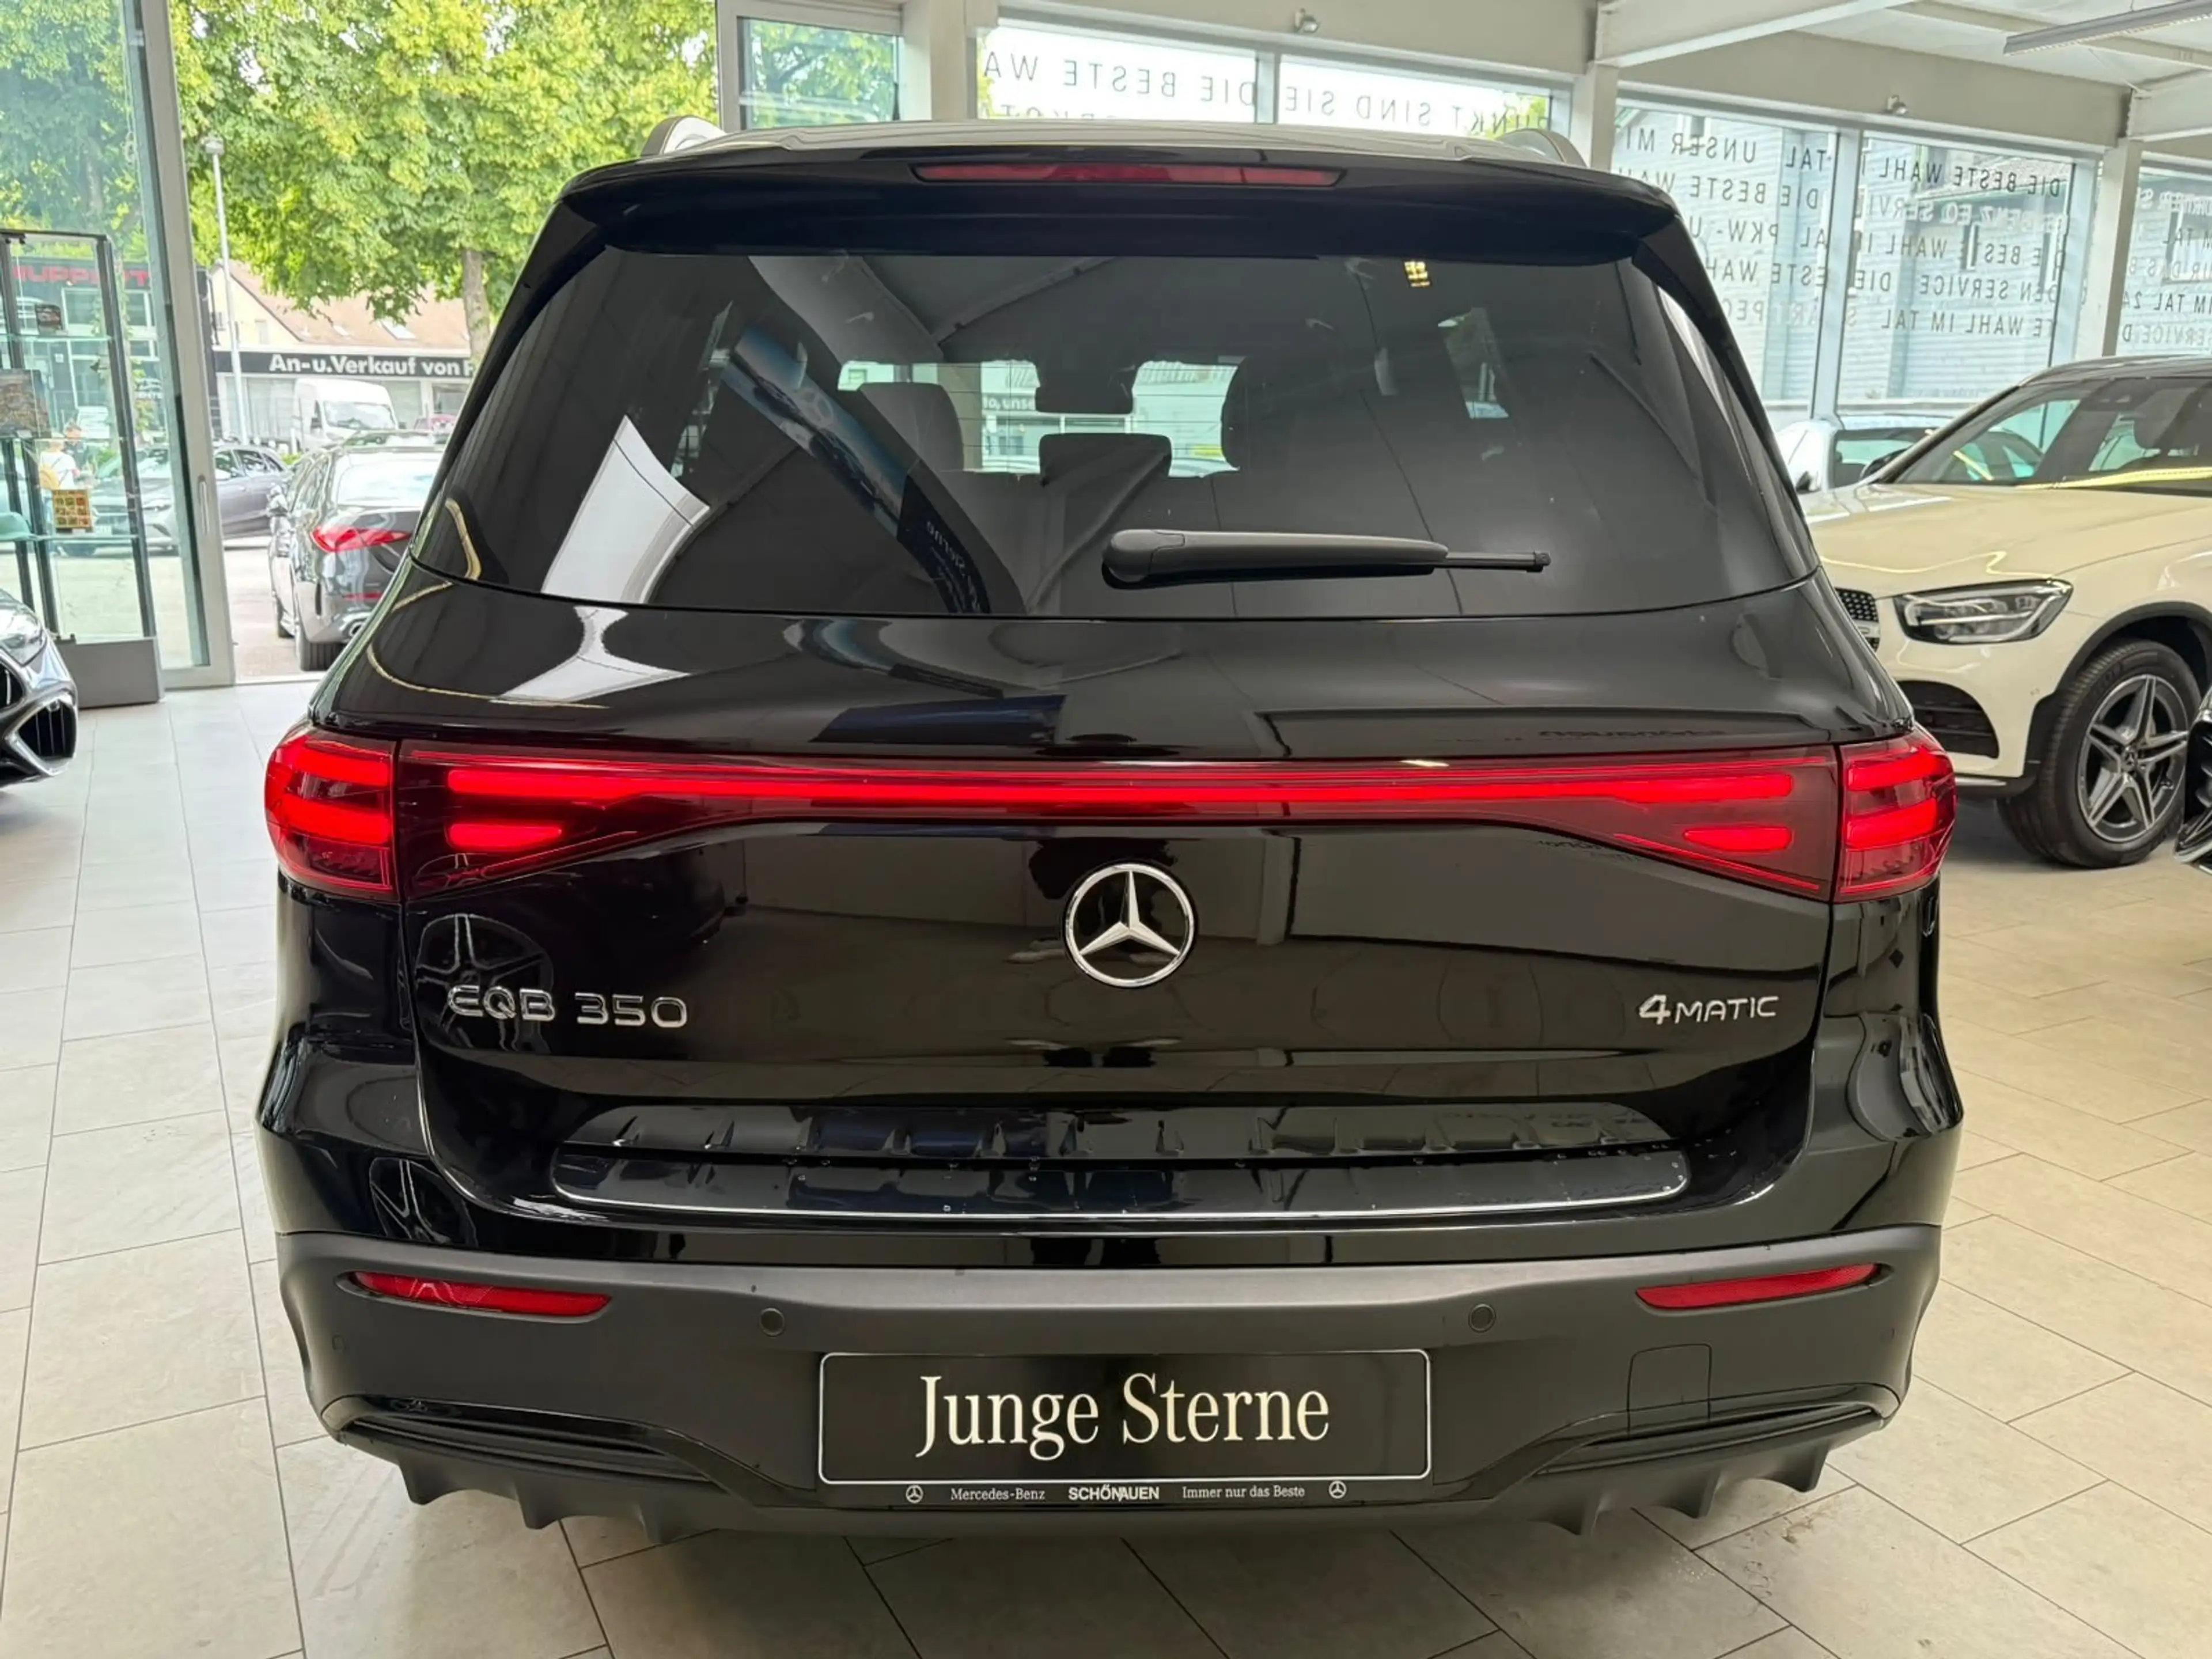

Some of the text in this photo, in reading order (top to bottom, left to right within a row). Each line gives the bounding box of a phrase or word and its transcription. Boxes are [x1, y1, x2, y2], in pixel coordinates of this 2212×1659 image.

[421, 361, 459, 376] von
[446, 984, 688, 1028] EQB 350
[1638, 994, 1780, 1025] 4MATIC
[915, 1372, 1329, 1461] Junge Sterne
[950, 1487, 1046, 1501] Mercedes-Benz
[1181, 1486, 1222, 1499] Immer
[1225, 1488, 1247, 1498] nur
[1249, 1485, 1270, 1498] das
[1272, 1484, 1306, 1498] Beste
